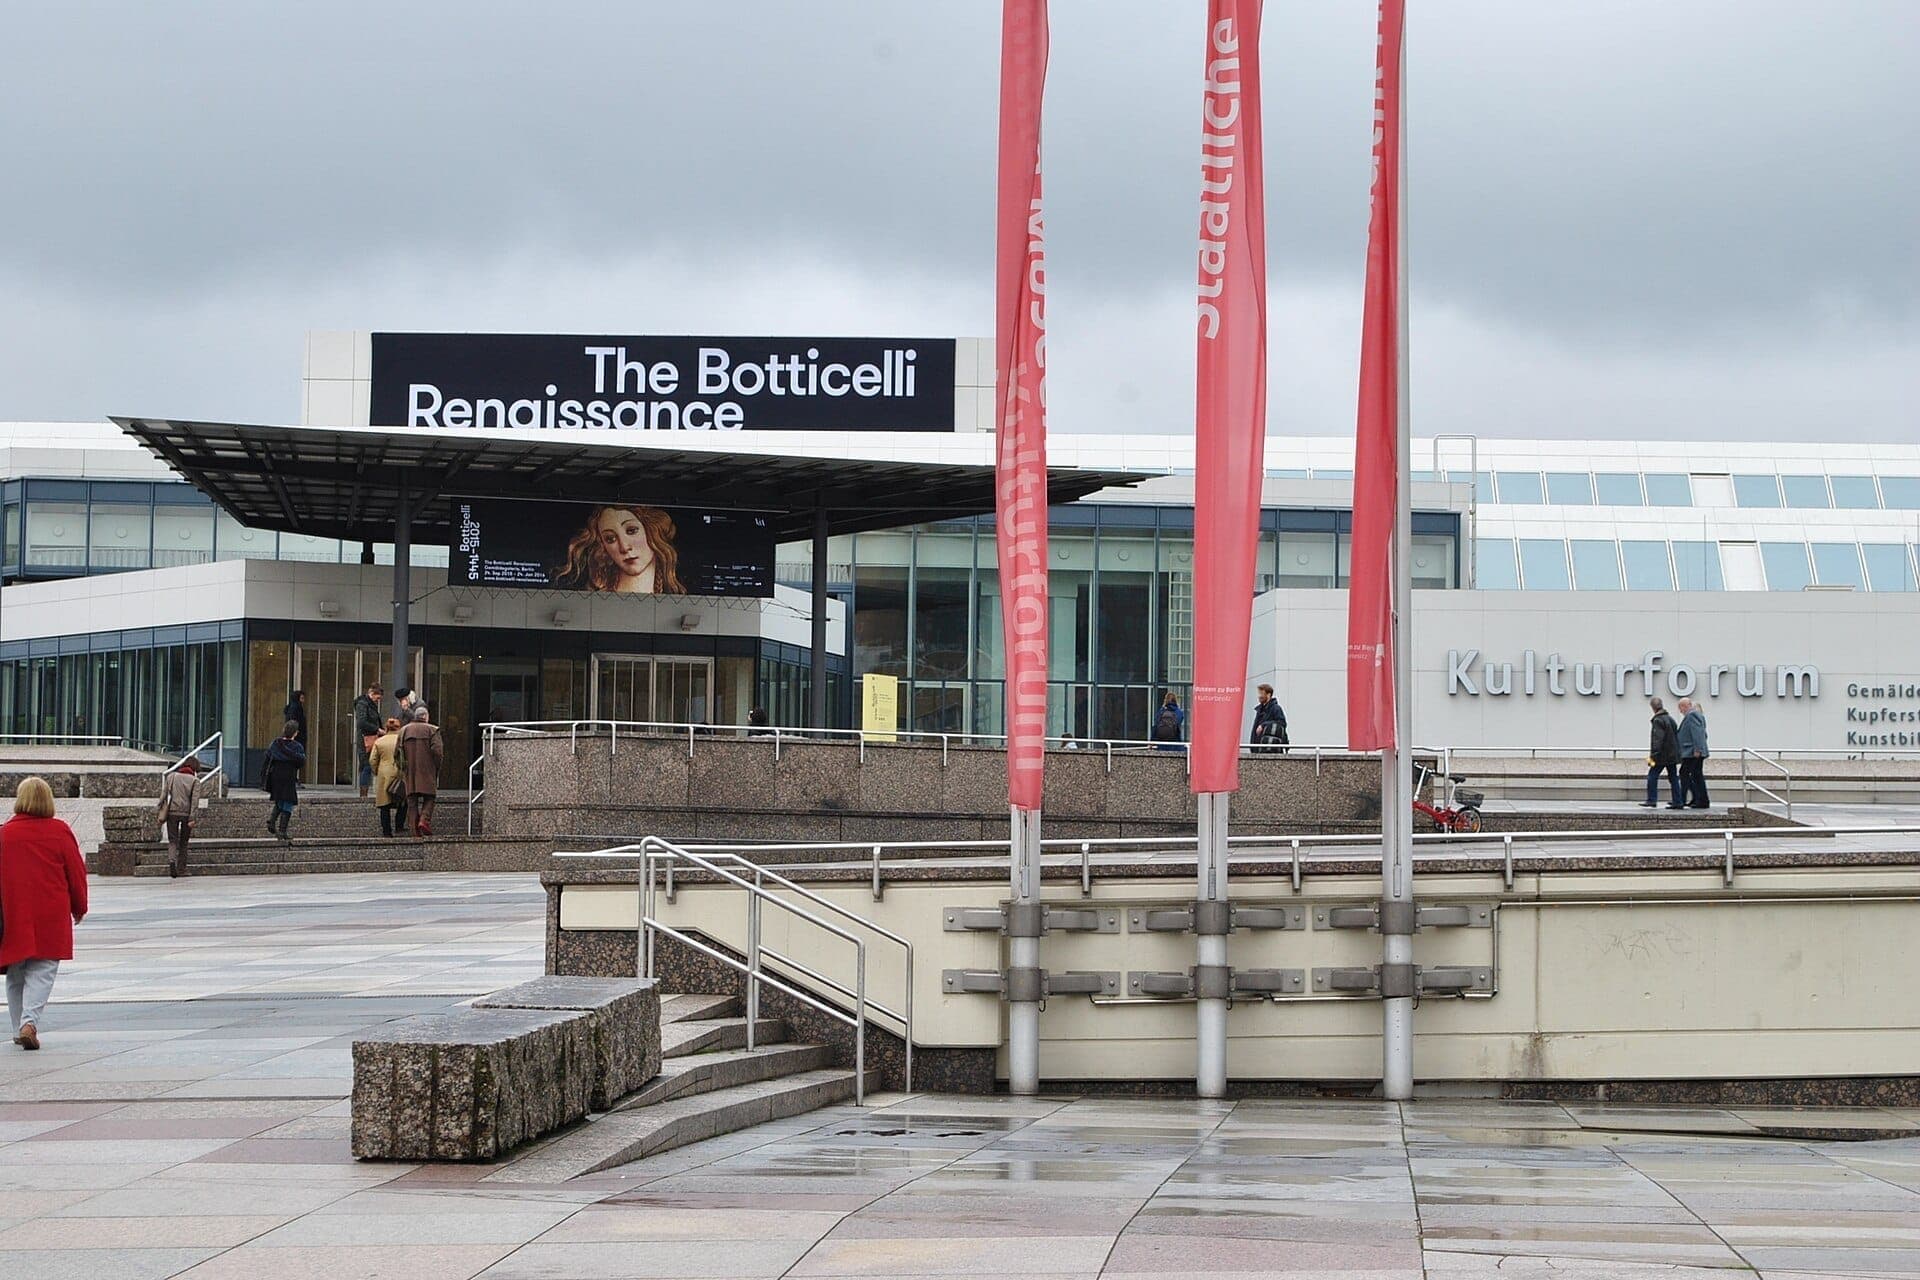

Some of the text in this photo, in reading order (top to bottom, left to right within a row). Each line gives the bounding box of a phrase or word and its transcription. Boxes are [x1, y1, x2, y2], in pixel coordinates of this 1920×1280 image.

[584, 346, 918, 397] The Botticelli
[408, 383, 745, 430] Renaissance
[459, 504, 470, 552] Botticelli
[1447, 649, 1821, 698] Kulturforum
